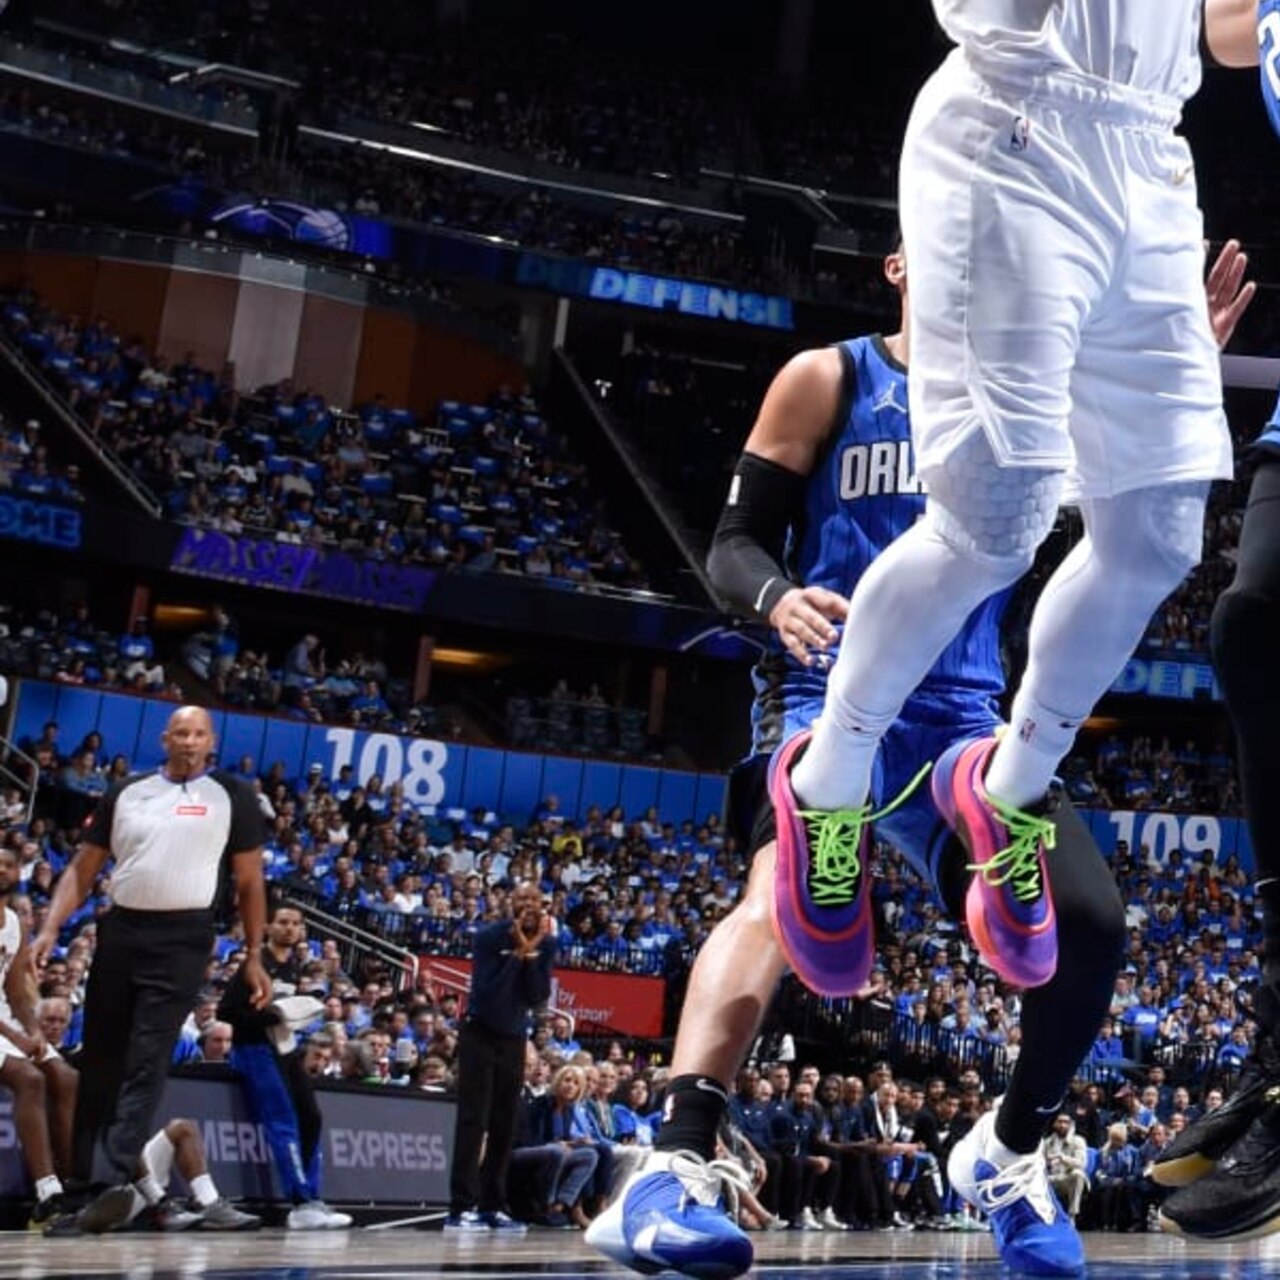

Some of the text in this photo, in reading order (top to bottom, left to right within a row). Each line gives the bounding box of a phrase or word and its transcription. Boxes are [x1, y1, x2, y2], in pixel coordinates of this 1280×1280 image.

[840, 441, 930, 500] ORL
[1111, 658, 1226, 701] DEF
[326, 728, 448, 807] 108
[1109, 811, 1221, 865] 109
[329, 1127, 448, 1171] EXPRESS
